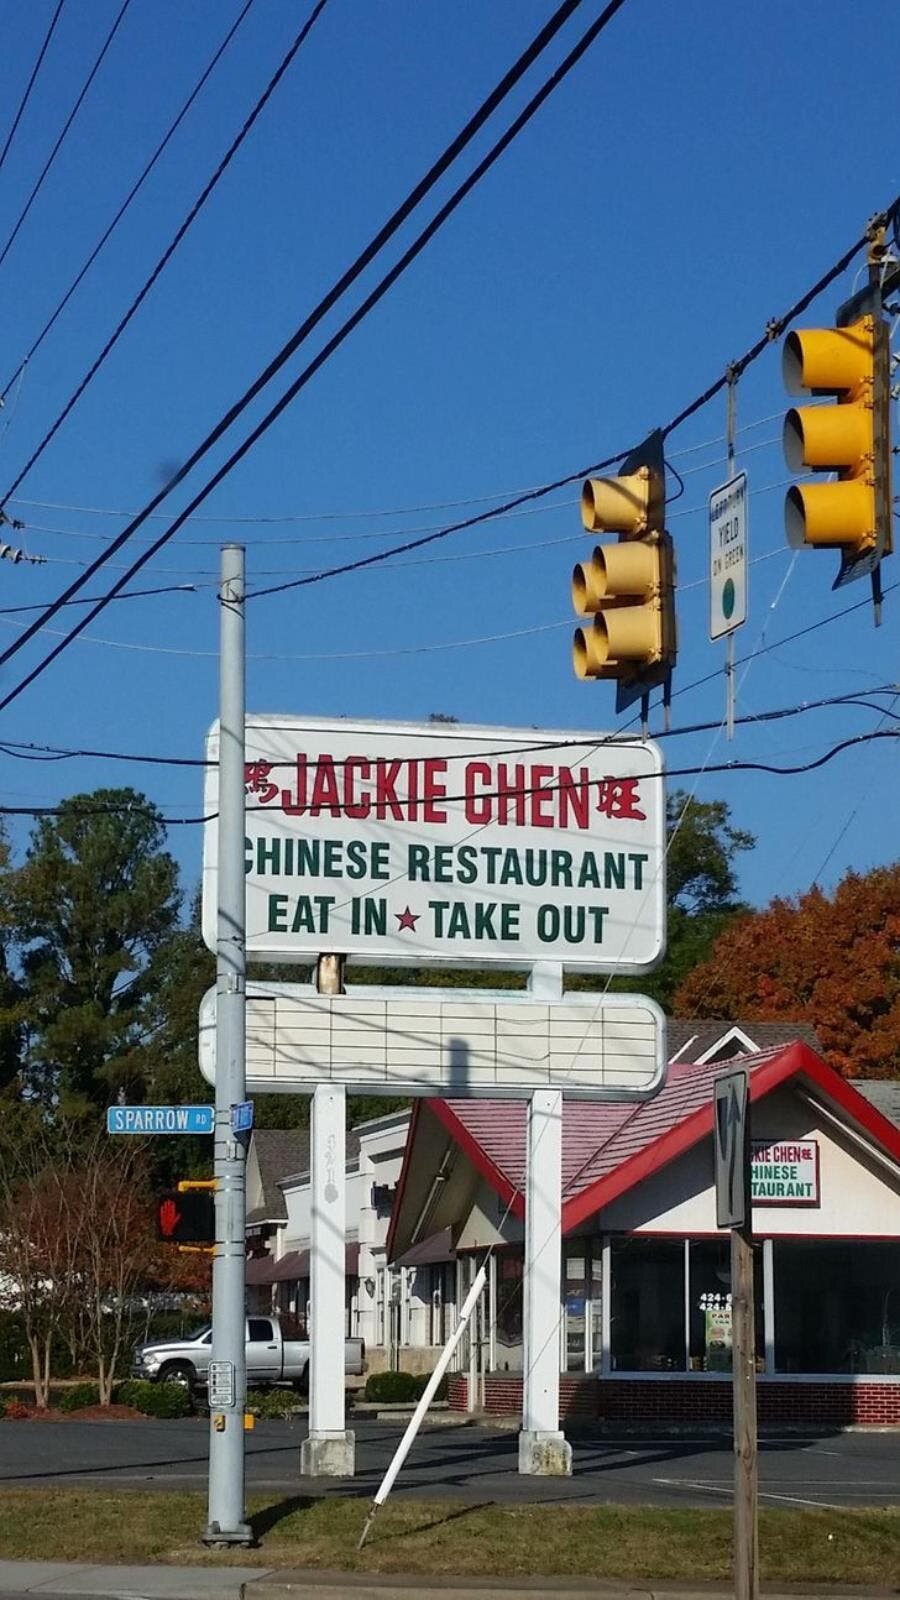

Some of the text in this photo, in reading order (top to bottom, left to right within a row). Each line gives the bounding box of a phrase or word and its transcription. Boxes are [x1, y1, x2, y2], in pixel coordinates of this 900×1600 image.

[719, 517, 738, 547] YIELD
[725, 546, 743, 569] GREEN
[281, 752, 448, 823] JACKIE
[465, 761, 590, 829] CHEN
[408, 843, 649, 890] RESTAURANT
[268, 893, 610, 944] EAT IN TAKE OUT
[115, 1110, 206, 1130] SPARROW RD
[752, 1146, 771, 1163] KIE
[773, 1146, 801, 1163] CHEN
[752, 1165, 797, 1179] HINESE
[752, 1182, 812, 1196] TAURANT
